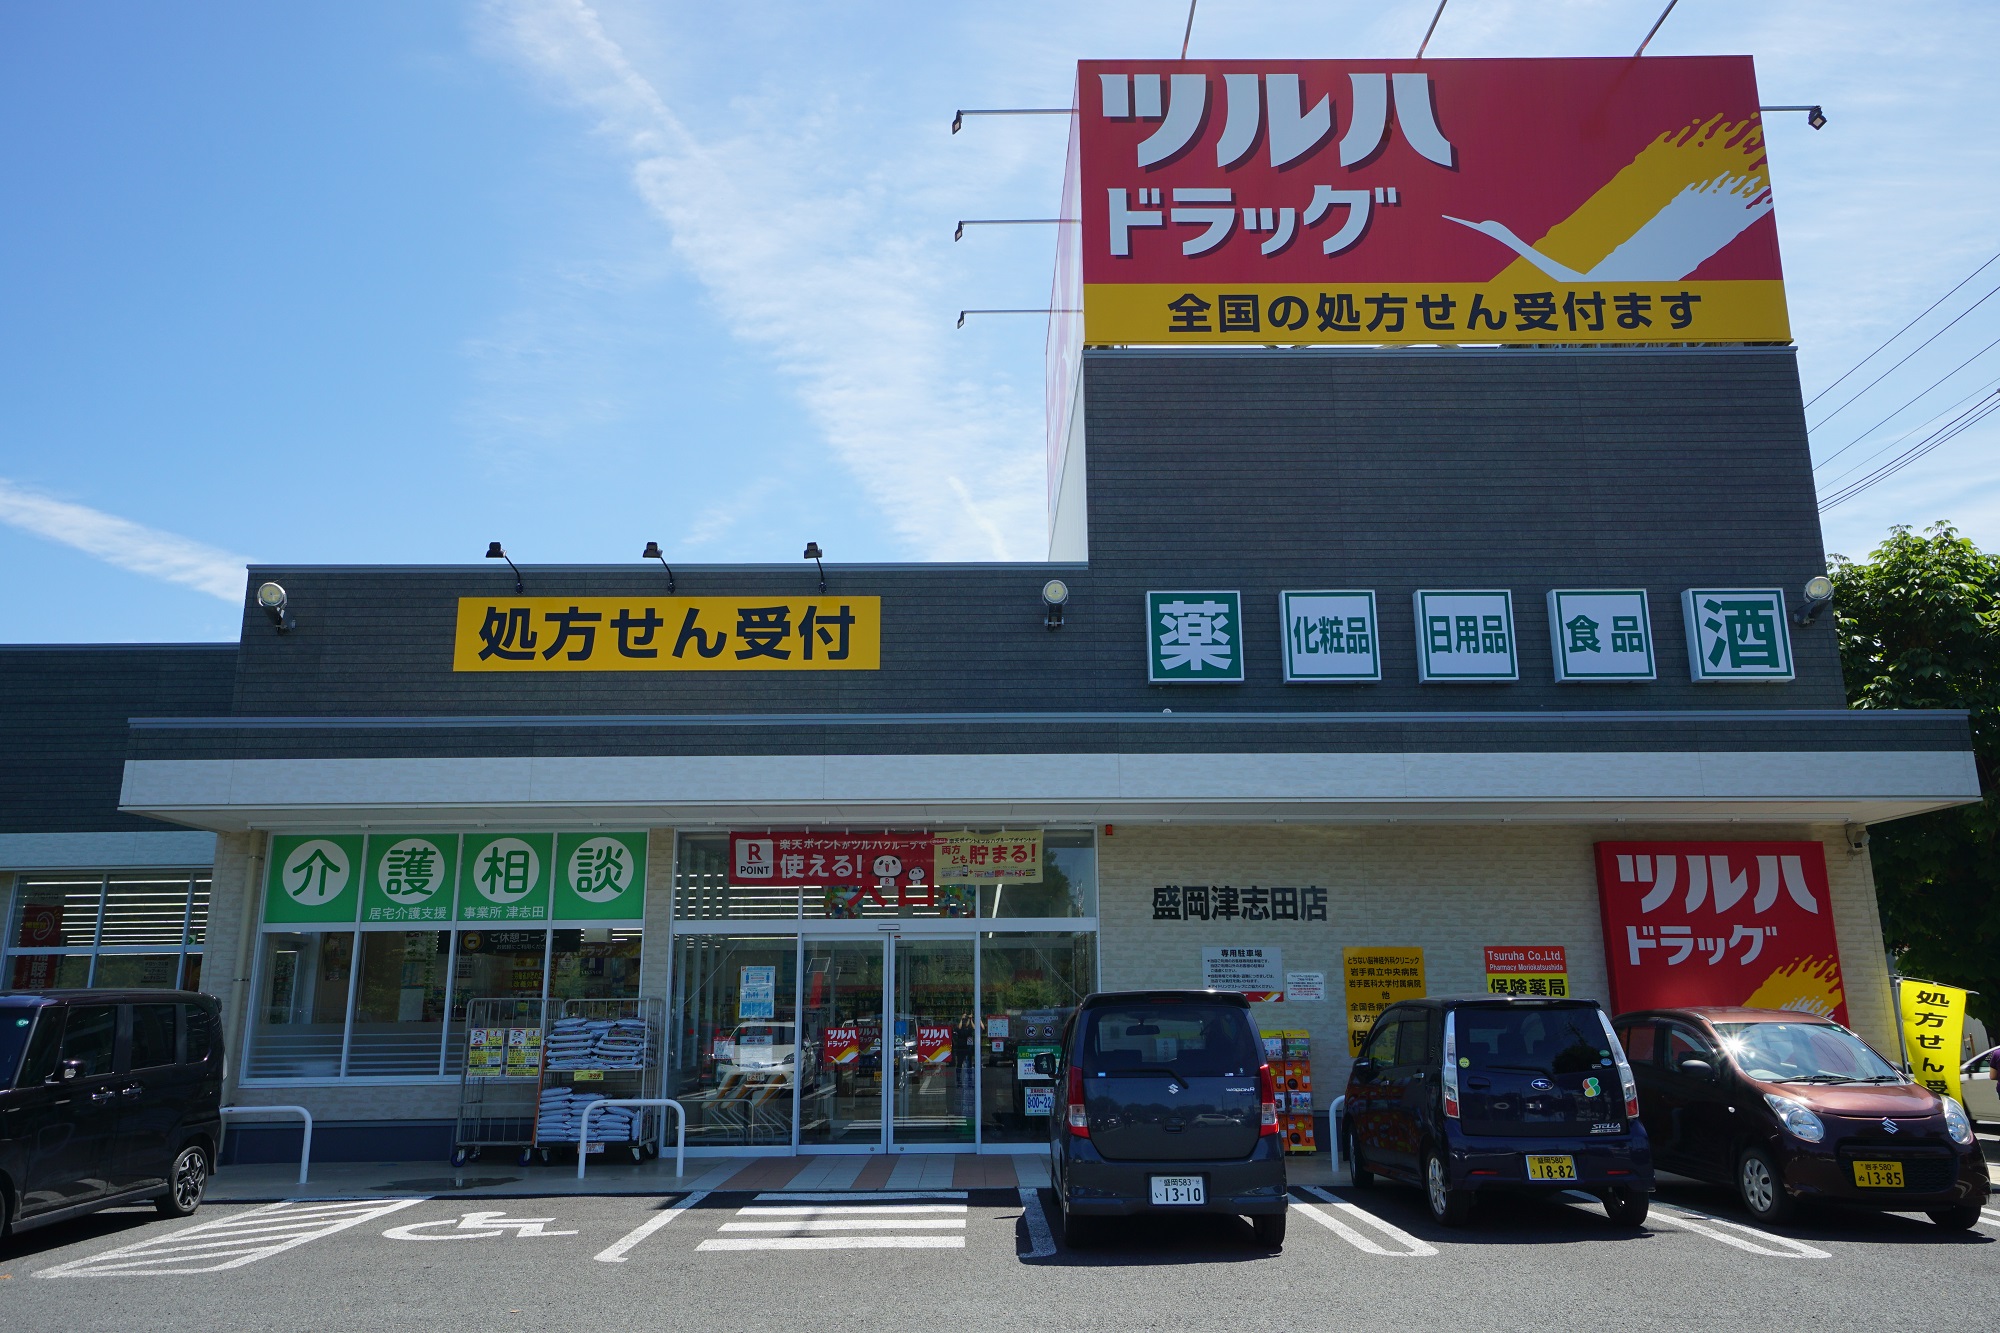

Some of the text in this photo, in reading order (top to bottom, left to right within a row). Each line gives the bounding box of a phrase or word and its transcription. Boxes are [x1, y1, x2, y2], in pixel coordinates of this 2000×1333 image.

[1098, 72, 1454, 168] ツルハ
[1106, 184, 1398, 257] ドラッグ
[1167, 290, 1703, 334] 全国の処方せん受付ます
[478, 604, 856, 661] 処方せん受付
[1158, 600, 1233, 671] 薬
[1293, 615, 1371, 655] 化粧品
[1428, 615, 1508, 654] 日用品
[1565, 614, 1645, 654] 食品
[1703, 598, 1781, 669] 酒
[779, 839, 927, 850] 楽天ポイントがツルハグループで
[740, 865, 770, 876] POINT
[779, 853, 863, 879] 使える!
[1615, 854, 1819, 915] ツルハ
[1152, 885, 1328, 921] 盛岡津志田店
[368, 906, 447, 920] 居宅介護支援
[463, 905, 544, 919] 事業所 津志田
[1625, 924, 1778, 966] ドラッグ
[1221, 949, 1263, 957] 専用駐車場
[1488, 950, 1563, 962] Tsuruha Co.,Ltd.
[1350, 967, 1419, 976] 岩手県立中央病院
[1489, 963, 1564, 972] Pharmacy Moriokatsushida
[1490, 978, 1566, 997] 保険薬局
[1381, 991, 1391, 1000] 他
[827, 1029, 857, 1039] ツルハ
[920, 1028, 949, 1039] ツルハ
[920, 1039, 943, 1047] ドラッグ
[1591, 1122, 1621, 1130] STELLA
[1539, 1165, 1574, 1178] 18-82
[1867, 1172, 1902, 1185] 13-85
[1165, 1187, 1201, 1202] 13-10
